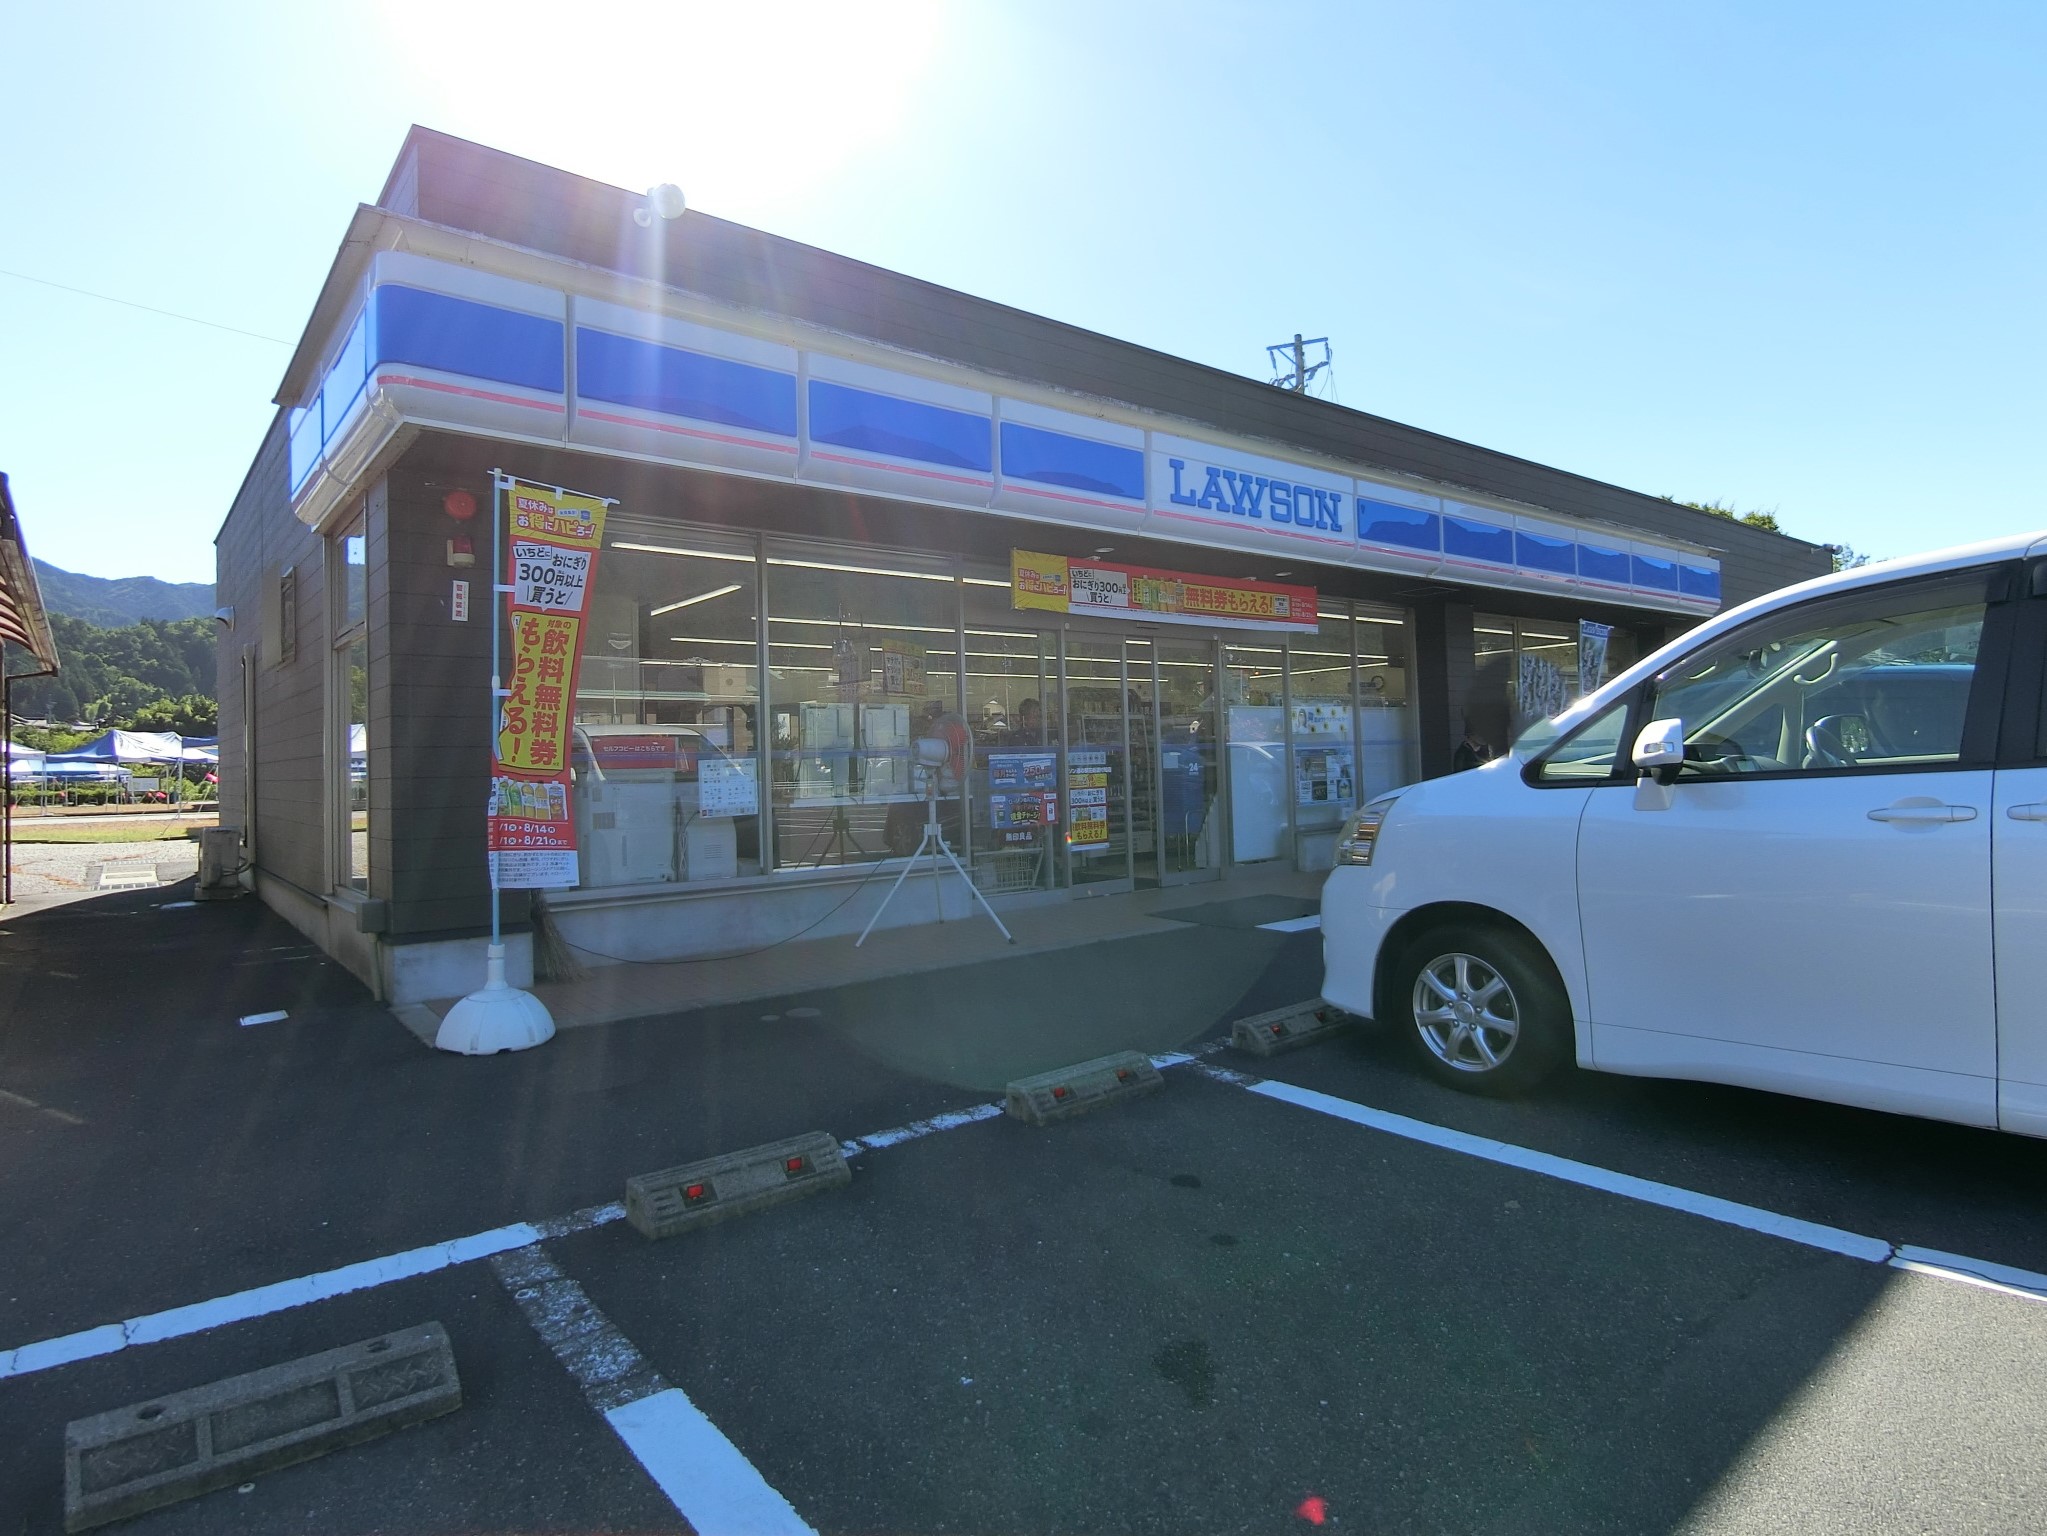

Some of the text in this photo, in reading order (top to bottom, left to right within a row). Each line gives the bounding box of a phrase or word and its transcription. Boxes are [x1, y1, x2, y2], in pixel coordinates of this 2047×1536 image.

[1169, 458, 1342, 532] LAWSON
[517, 497, 554, 514] 夏休みは
[515, 547, 551, 558] いちどに
[552, 553, 587, 571] おにぎり
[518, 562, 583, 588] 300円以上
[529, 585, 567, 605] 買うと
[1089, 591, 1110, 604] 買うと
[529, 629, 570, 766] 飲料無料券
